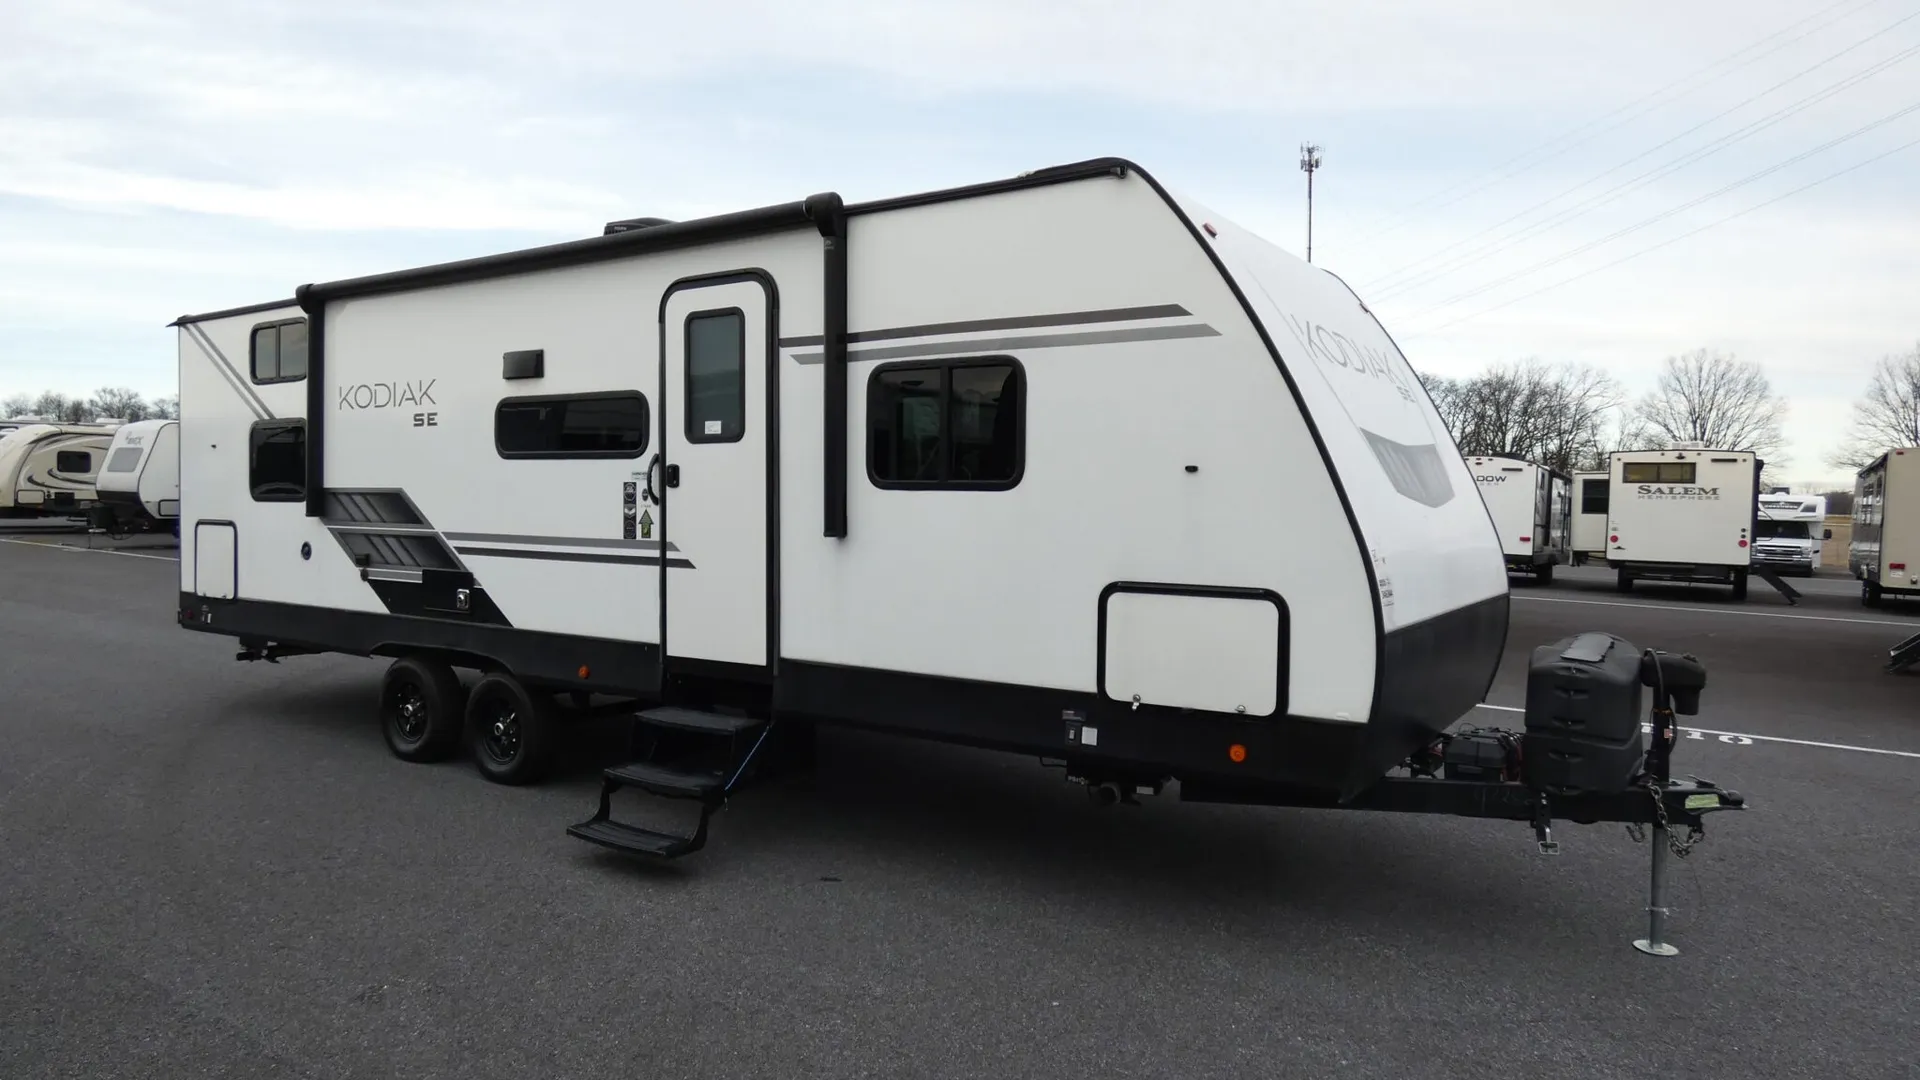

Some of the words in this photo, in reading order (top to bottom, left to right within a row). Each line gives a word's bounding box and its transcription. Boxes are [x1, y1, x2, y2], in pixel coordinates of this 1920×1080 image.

[1290, 313, 1408, 387] KODIAK
[338, 378, 437, 411] KODIAK
[413, 412, 438, 427] SE
[1637, 484, 1720, 496] SALEM
